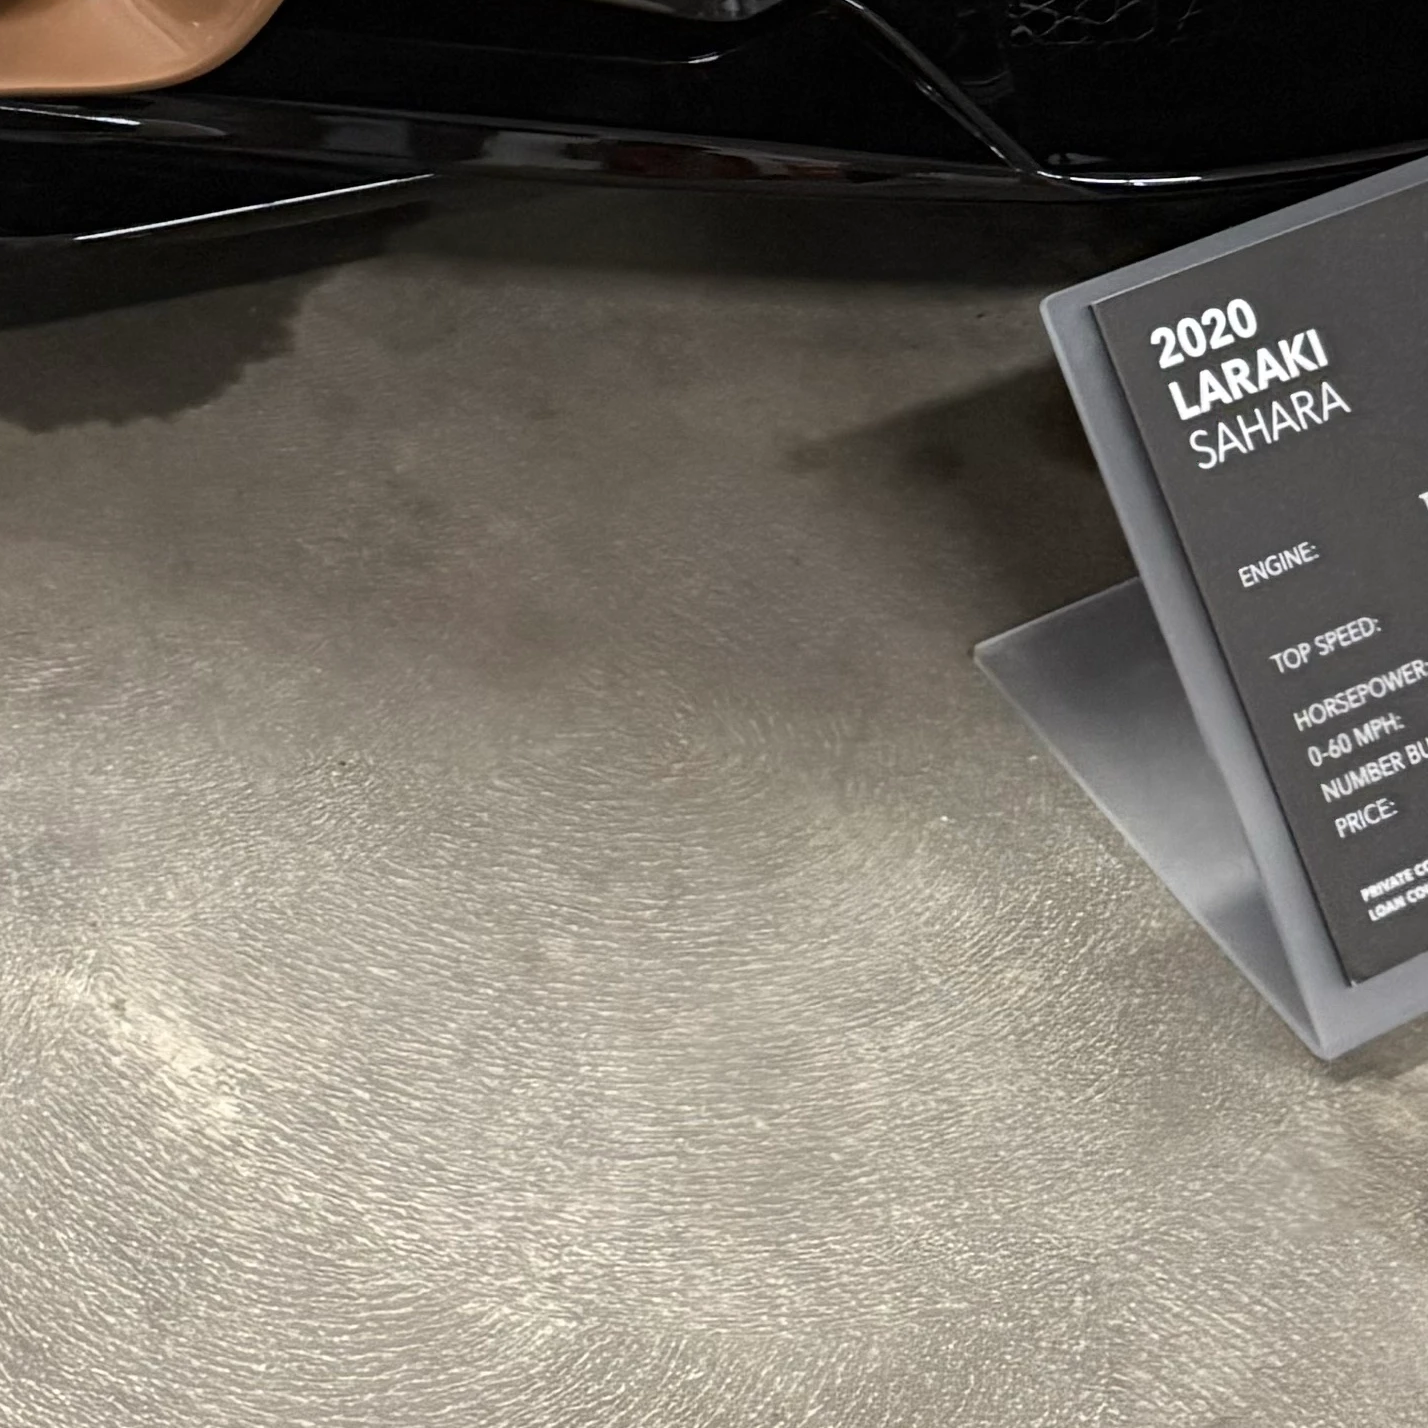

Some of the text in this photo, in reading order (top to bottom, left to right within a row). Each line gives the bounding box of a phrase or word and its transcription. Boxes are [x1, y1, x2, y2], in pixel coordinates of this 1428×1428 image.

[1150, 298, 1258, 370] 2020
[1167, 328, 1329, 421] LARAKI
[1189, 381, 1352, 470] SAHARA
[1238, 541, 1320, 588] ENGINE:
[1269, 642, 1312, 674] TOP
[1314, 616, 1382, 656] SPEED:
[1307, 732, 1353, 767] 0-60
[1352, 712, 1405, 747] MPH:
[1320, 751, 1406, 803] NUMBER
[1334, 797, 1398, 838] PRICE:
[1360, 868, 1415, 902] PRIVATE
[1368, 895, 1407, 922] LOAN
